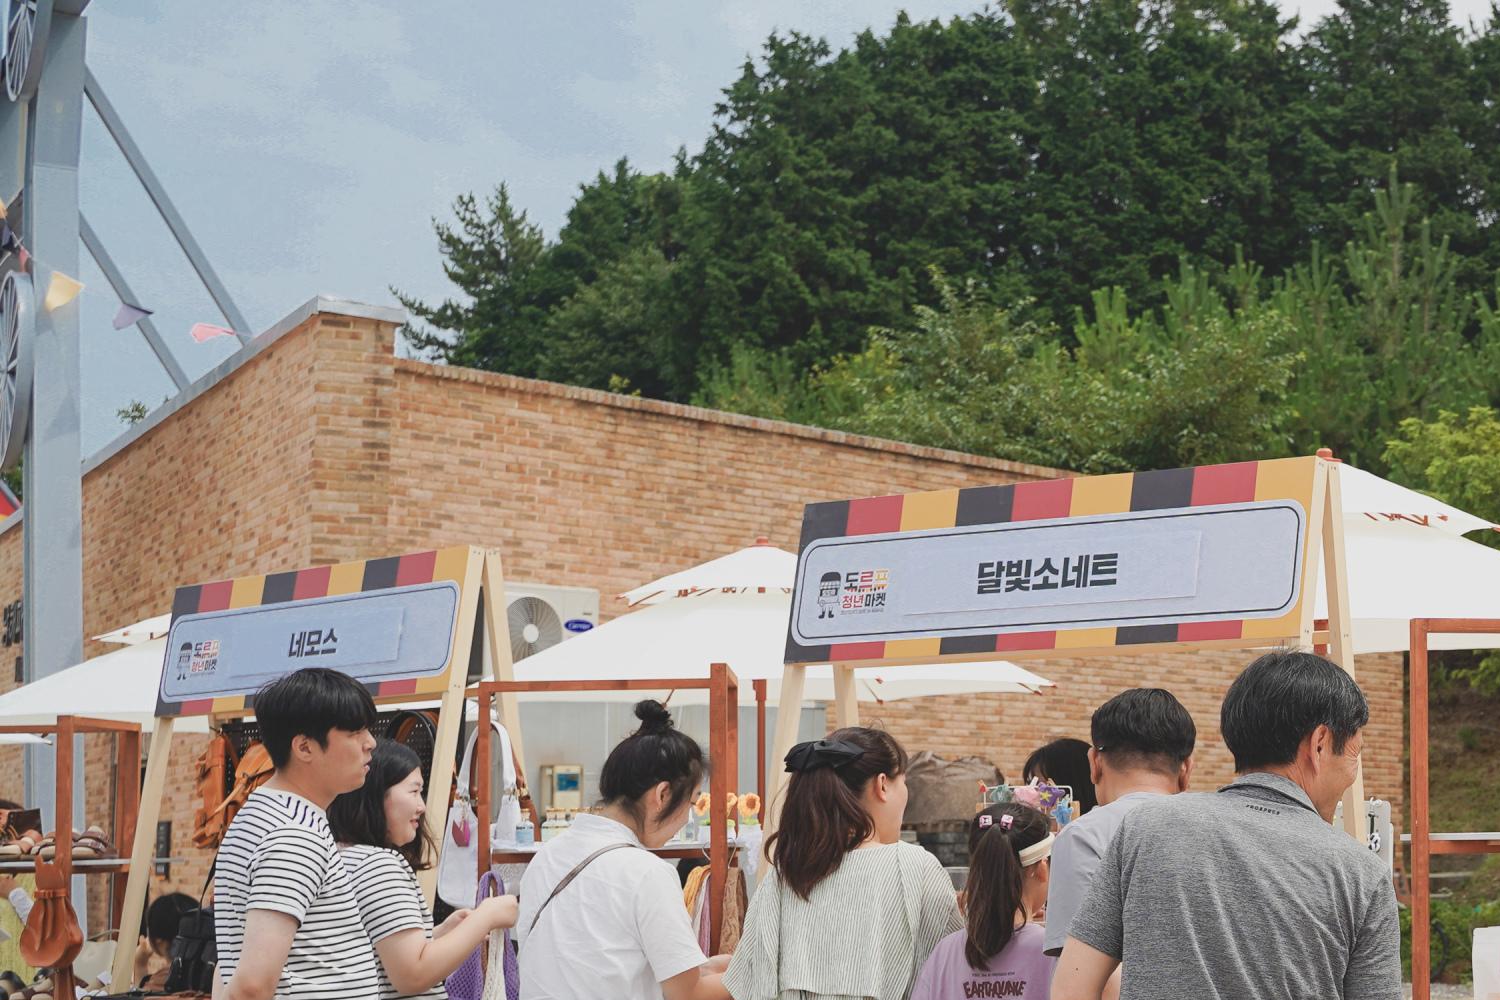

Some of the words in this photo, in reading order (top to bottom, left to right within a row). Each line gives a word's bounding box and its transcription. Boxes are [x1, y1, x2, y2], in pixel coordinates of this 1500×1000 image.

[976, 552, 1119, 595] 달빛소네트
[842, 592, 887, 609] 청년마켓
[287, 627, 338, 658] 네모스
[963, 980, 1027, 999] EARTHQUAKE
